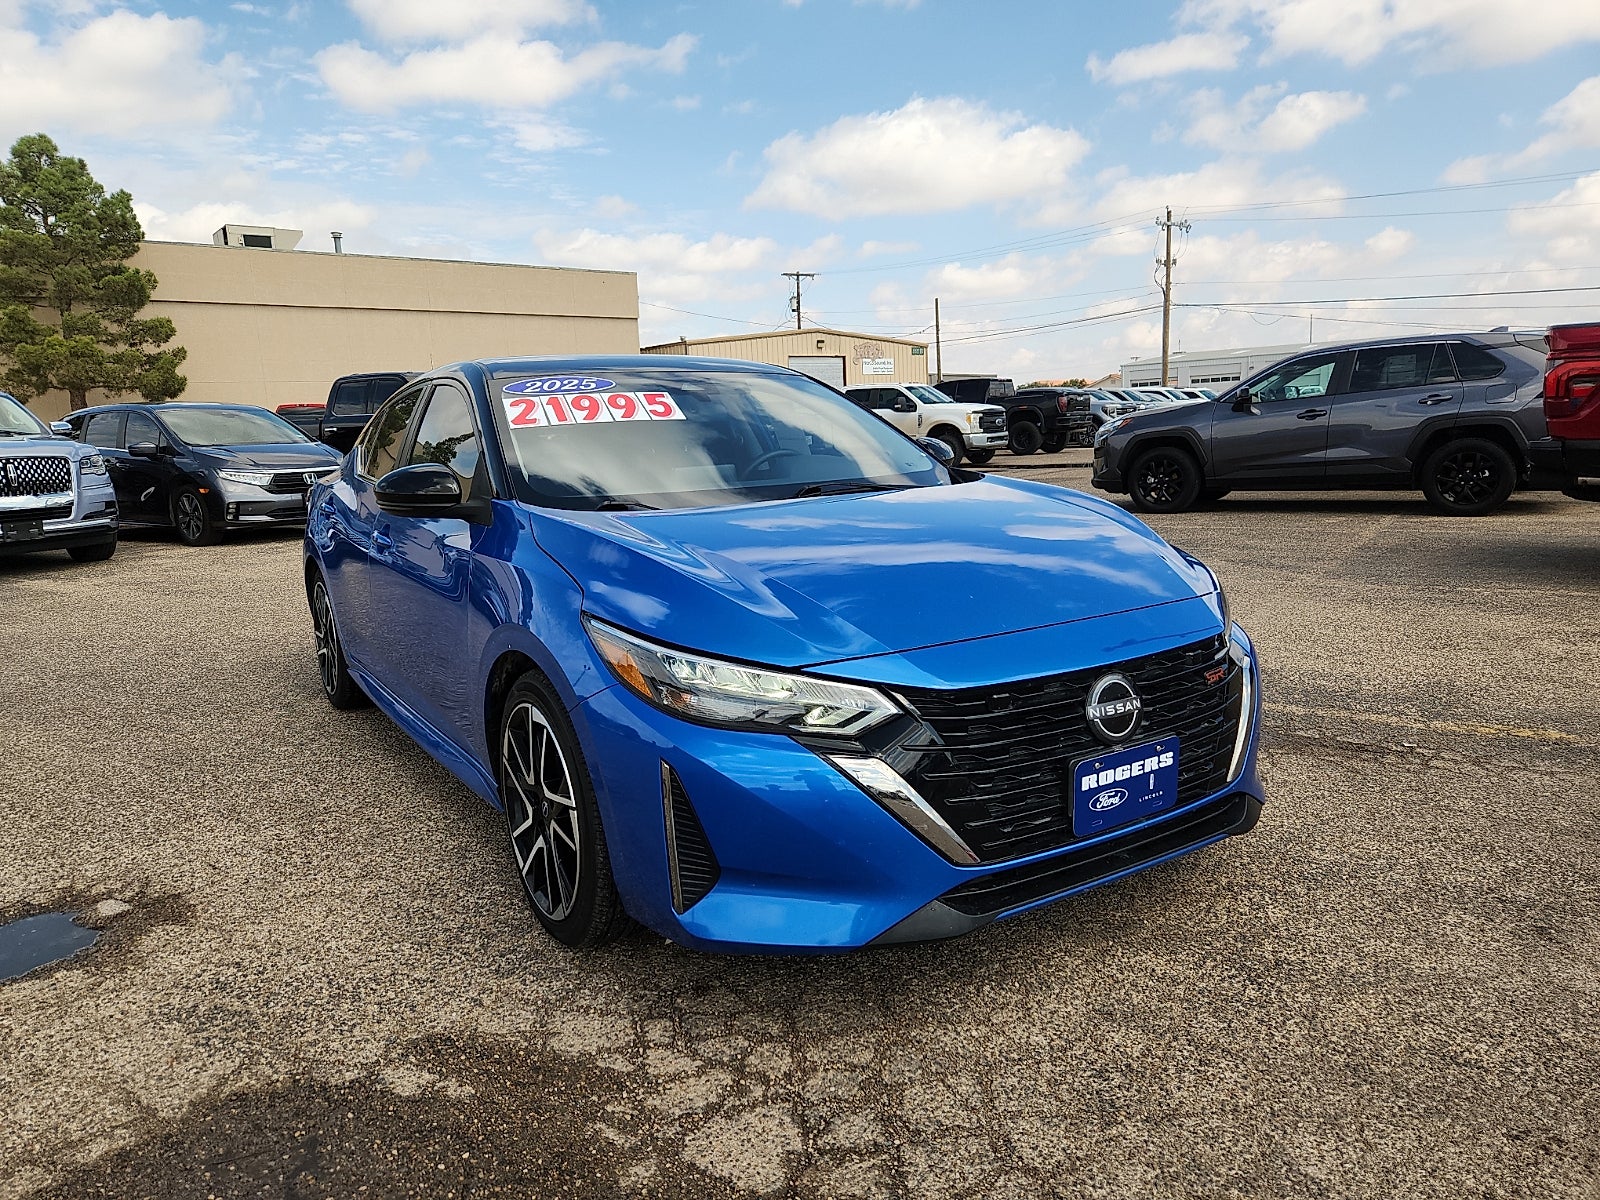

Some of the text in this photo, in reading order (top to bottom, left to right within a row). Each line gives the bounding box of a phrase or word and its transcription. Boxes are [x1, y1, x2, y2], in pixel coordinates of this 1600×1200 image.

[522, 377, 598, 393] 2025
[509, 393, 675, 426] 21995
[1088, 698, 1141, 719] NISSAN
[1080, 751, 1174, 792] ROGERS
[1096, 791, 1121, 809] Ford
[1138, 790, 1163, 803] LINCOLN
